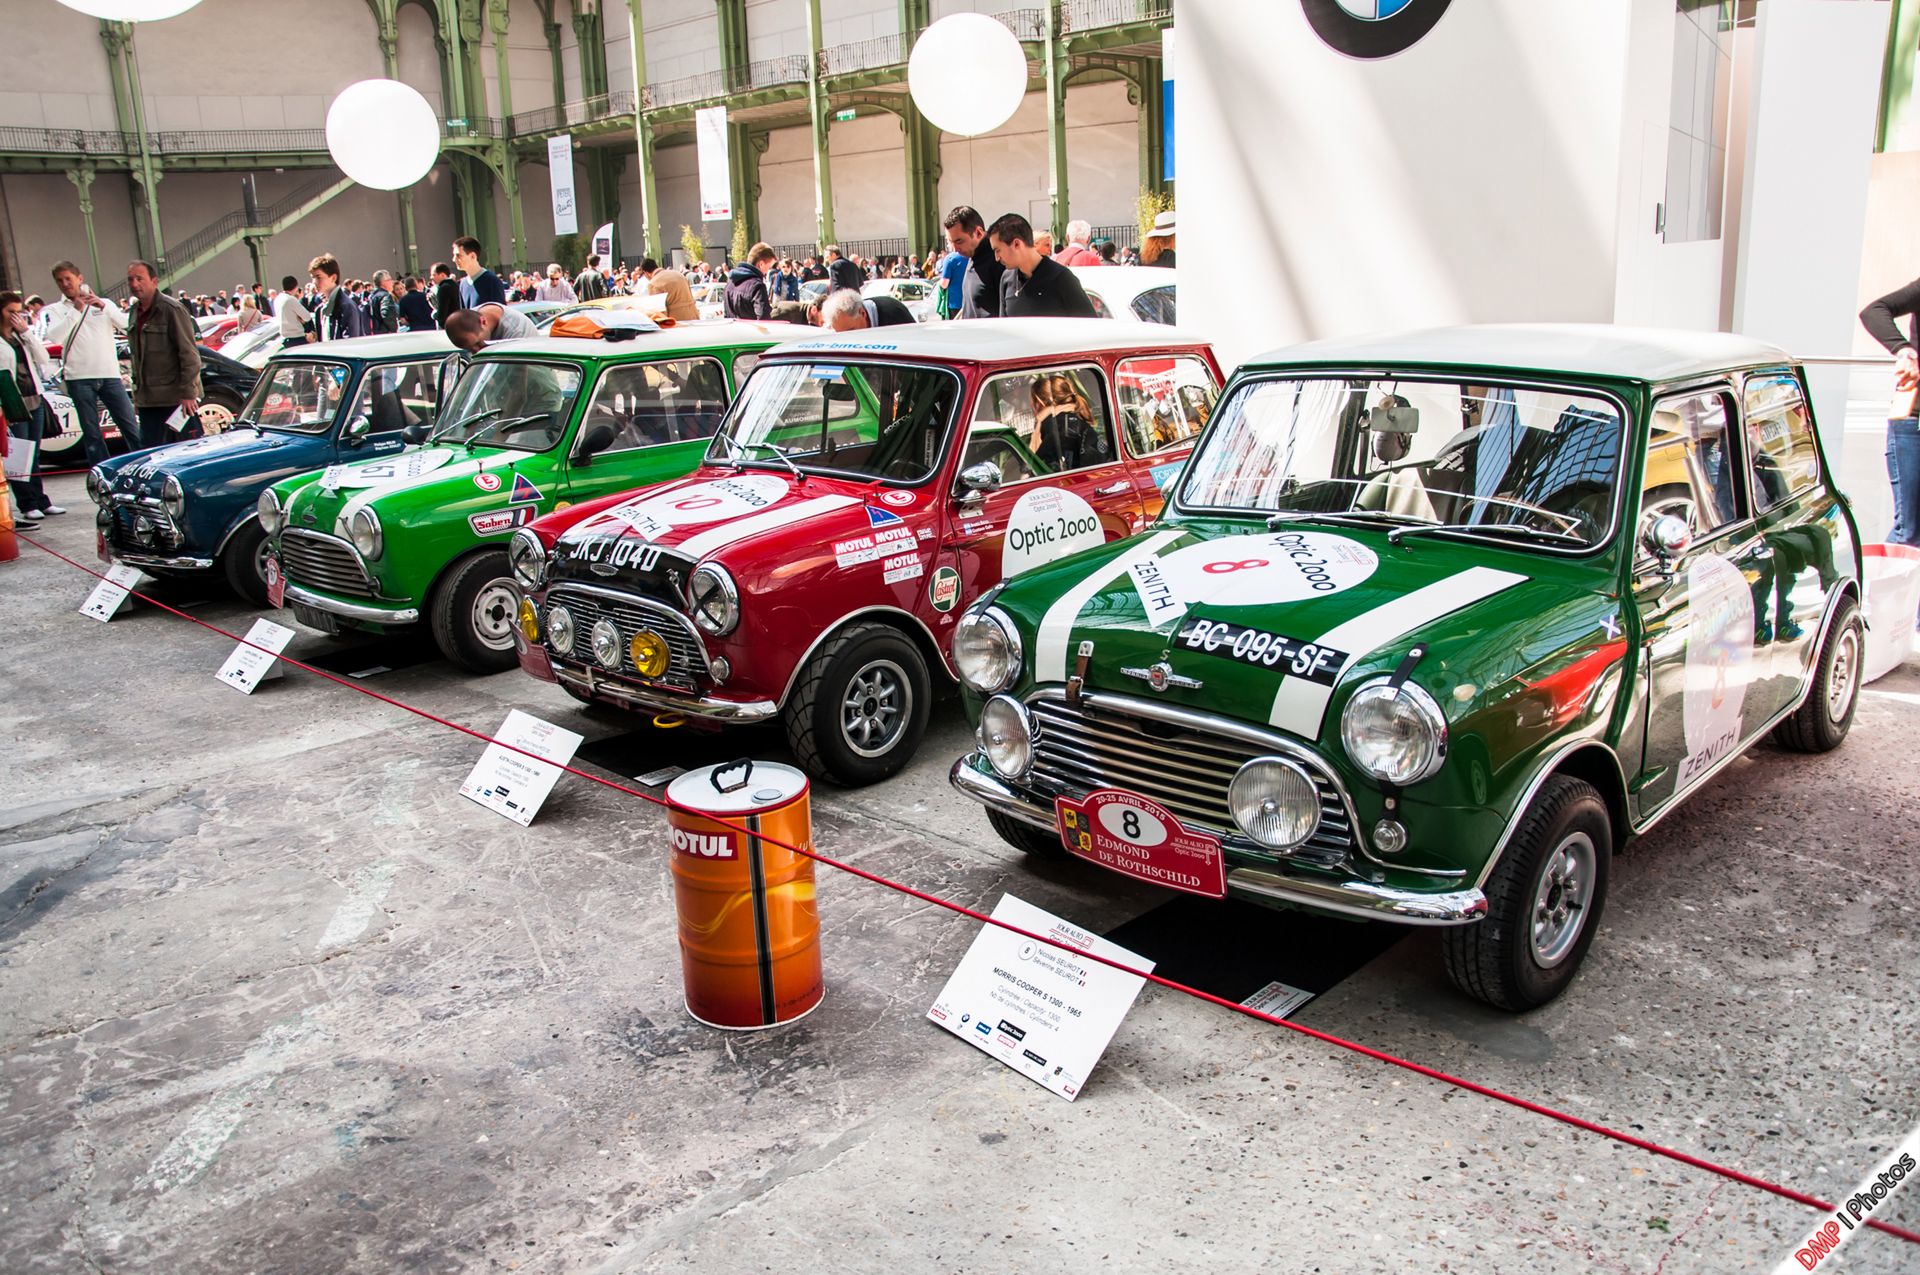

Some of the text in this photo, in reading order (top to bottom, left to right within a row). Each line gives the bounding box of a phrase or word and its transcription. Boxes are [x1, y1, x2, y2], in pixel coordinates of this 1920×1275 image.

[798, 342, 898, 351] auto-bmc.com
[481, 476, 494, 485] E
[665, 494, 723, 511] 10
[890, 493, 907, 501] E
[616, 508, 662, 534] ZENITH
[834, 536, 875, 554] MOTUL
[875, 526, 912, 544] MOTUL
[1009, 521, 1055, 555] Optic
[1057, 515, 1097, 540] 2000
[608, 538, 663, 573] 104D
[884, 552, 920, 571] MOTUL
[1202, 559, 1270, 574] 8
[1268, 533, 1338, 592] Optic 2000
[1133, 560, 1176, 611] ZENITH
[1187, 619, 1336, 677] BC-095-SF
[1683, 727, 1737, 780] ZENITH
[1096, 796, 1166, 821] 20-25 AVRIL 2015
[1122, 810, 1141, 839] 8
[1096, 833, 1150, 860] EDMOND
[1099, 851, 1201, 887] DE ROTHSCHILD
[993, 967, 1017, 984] MORRIS
[1016, 979, 1043, 997] COOPER
[1048, 996, 1063, 1008] 1300
[1067, 1006, 1083, 1018] 1965
